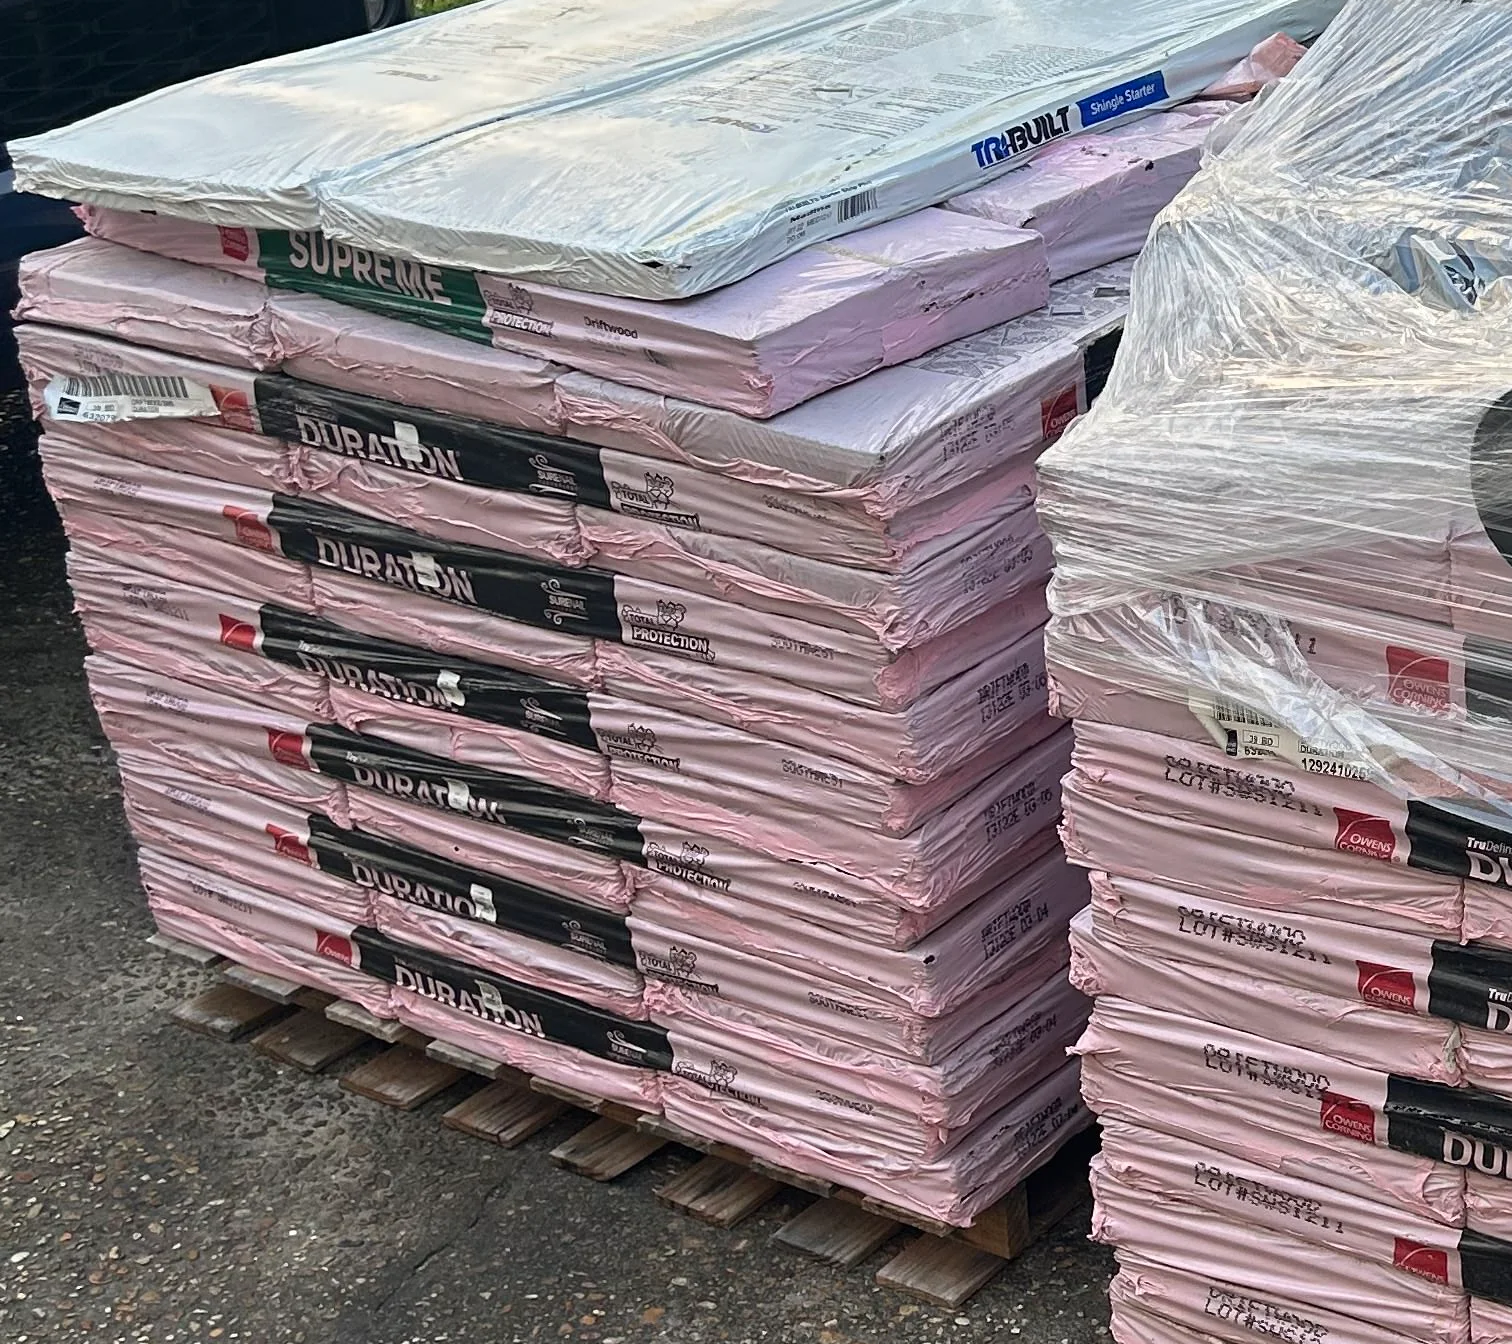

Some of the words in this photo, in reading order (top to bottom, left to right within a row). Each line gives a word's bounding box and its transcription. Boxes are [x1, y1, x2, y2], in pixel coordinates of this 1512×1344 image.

[1090, 93, 1124, 117] Shingle
[1124, 81, 1156, 103] Starter
[288, 231, 453, 306] SUPREME
[492, 311, 554, 336] PROTECTION
[584, 315, 639, 340] Driftwood
[298, 417, 464, 482] DURATON
[621, 490, 649, 505] TOTAL
[317, 536, 478, 605] DURATON
[629, 613, 655, 626] TOTAL
[633, 626, 709, 653] PROTECTION
[1393, 688, 1450, 709] CORNING
[1402, 678, 1449, 698] OWENS
[1350, 833, 1392, 854] OWENS
[657, 861, 731, 893] PROTECTION
[351, 860, 497, 923] DURATIO
[646, 955, 673, 972] TOTAL
[395, 966, 547, 1039] DURATON
[1370, 986, 1412, 1006] OWENS
[1325, 1119, 1373, 1143] CORNING
[1333, 1114, 1373, 1134] OWENS
